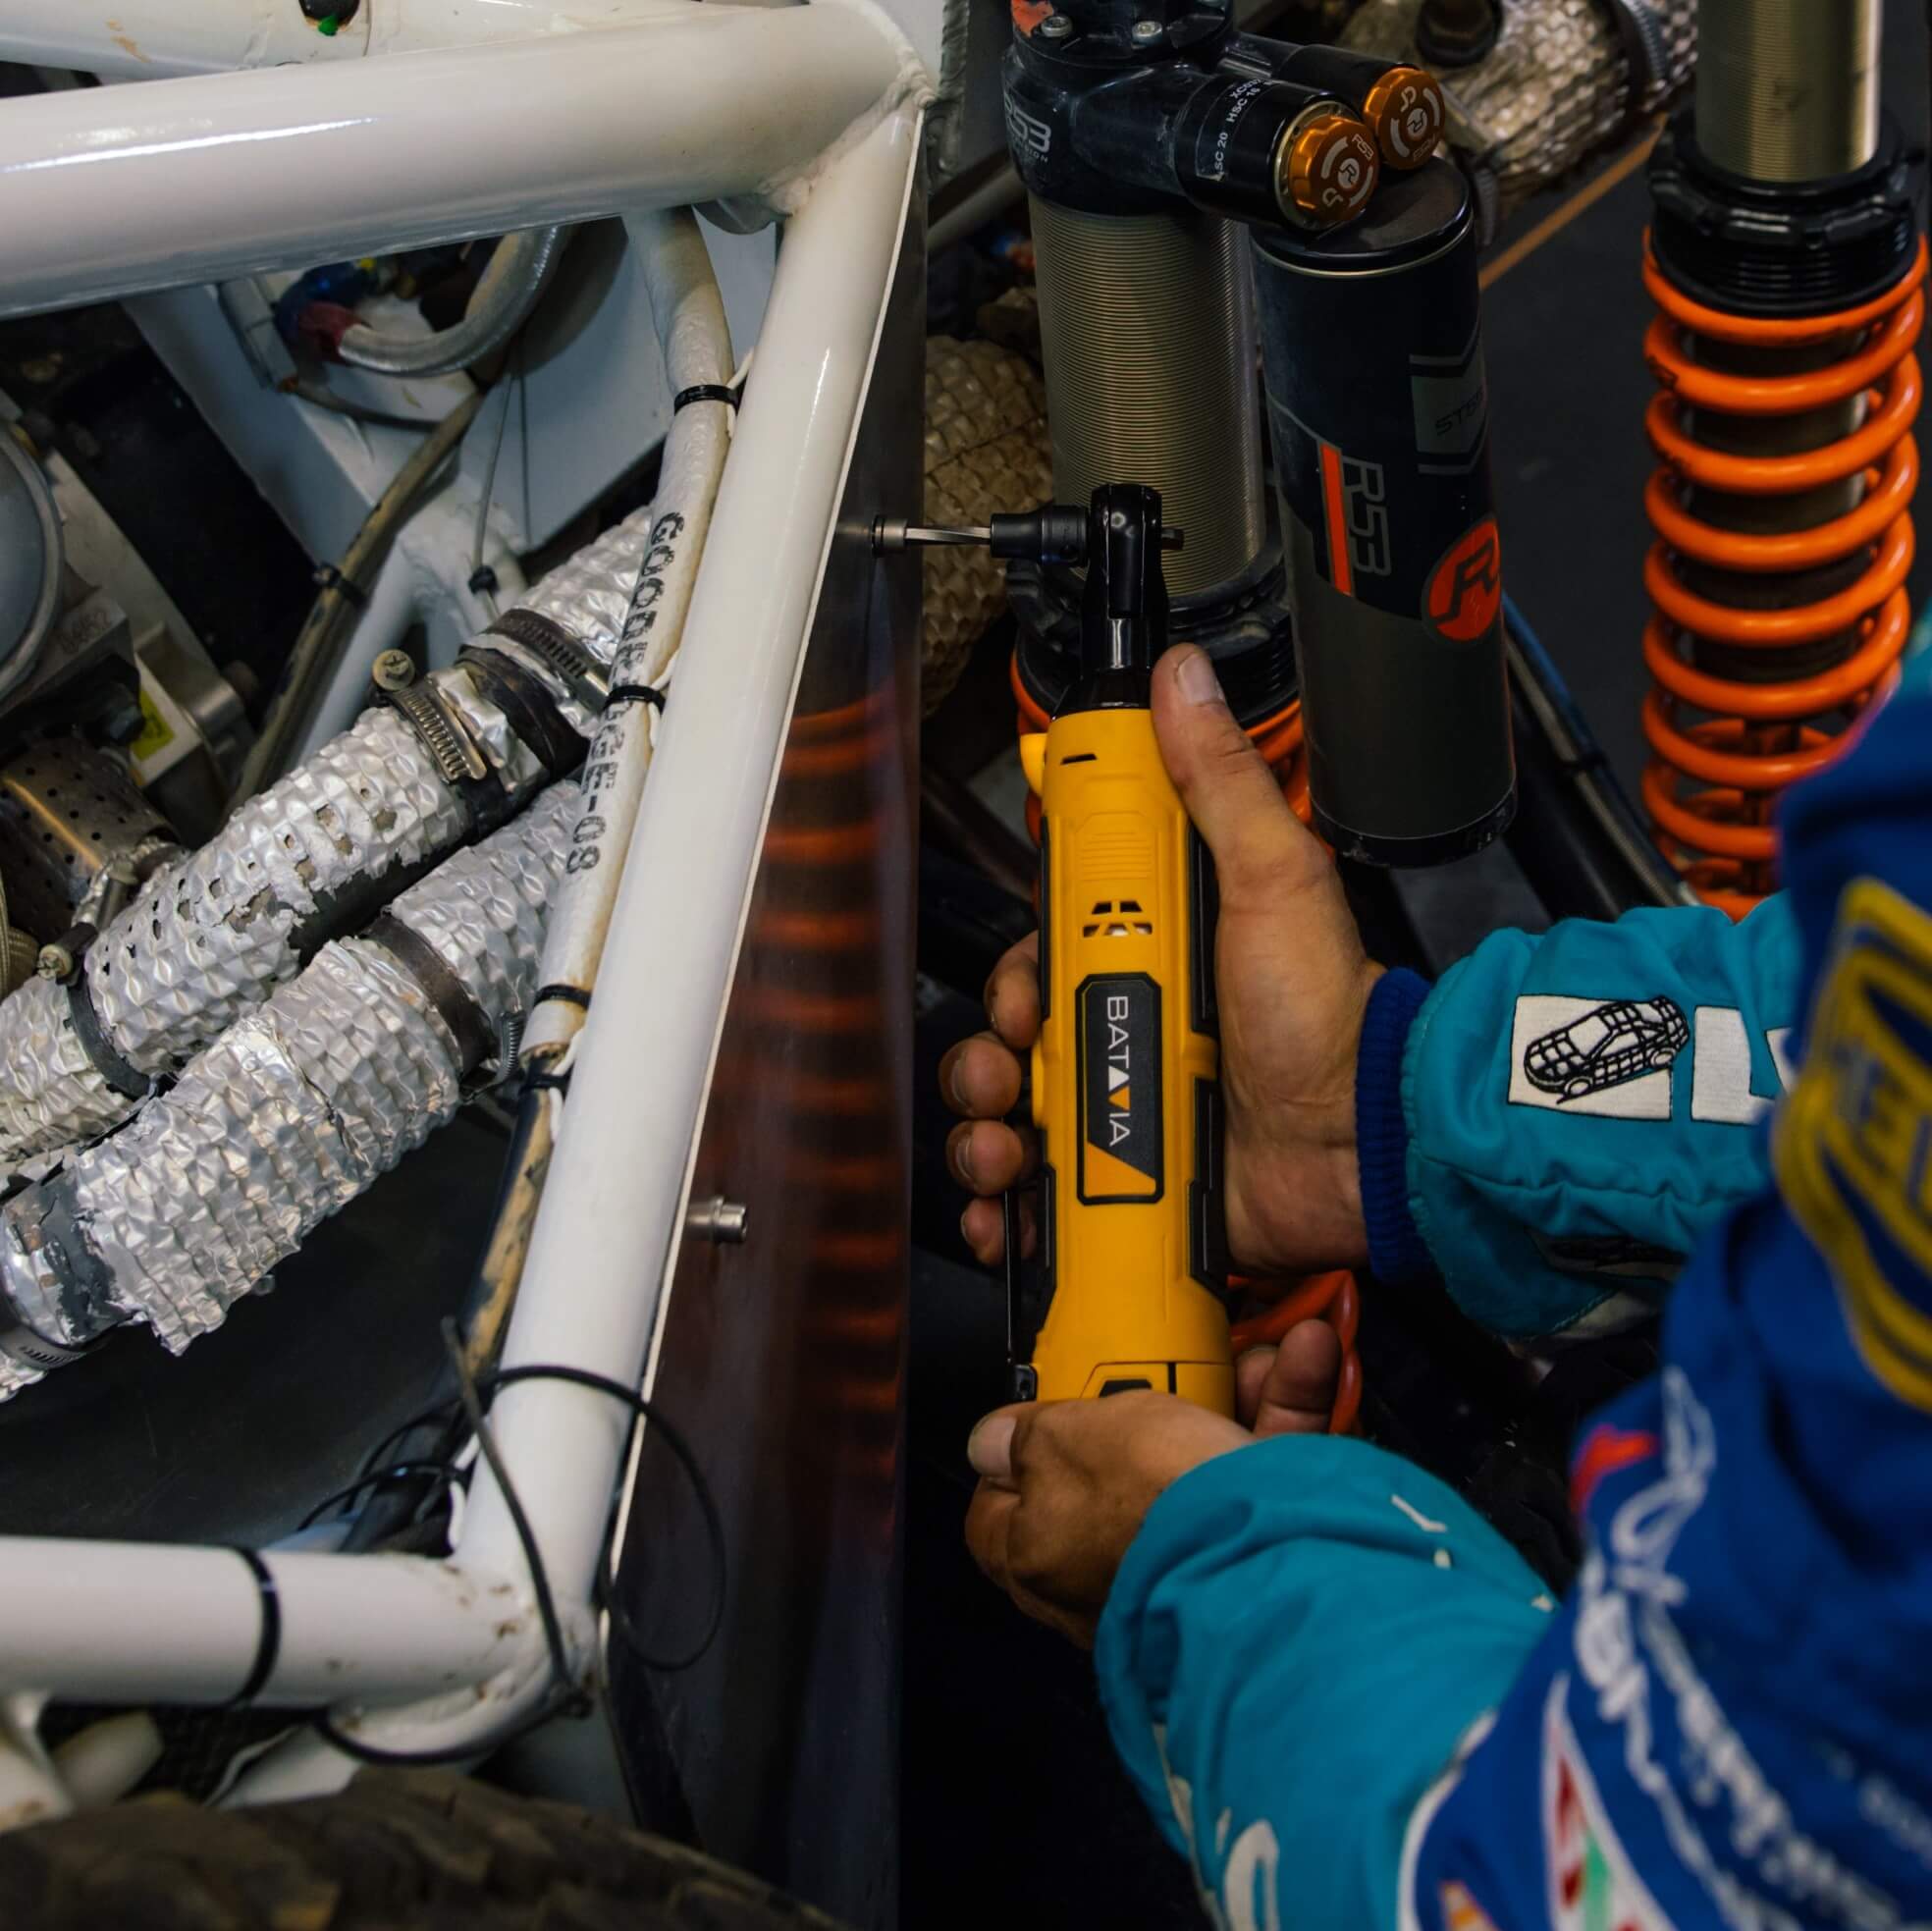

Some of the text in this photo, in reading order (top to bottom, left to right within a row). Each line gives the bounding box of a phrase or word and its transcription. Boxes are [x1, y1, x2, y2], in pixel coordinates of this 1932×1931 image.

[1216, 132, 1229, 148] 20
[1225, 98, 1249, 123] HSC
[1106, 995, 1131, 1148] BATAVIA
